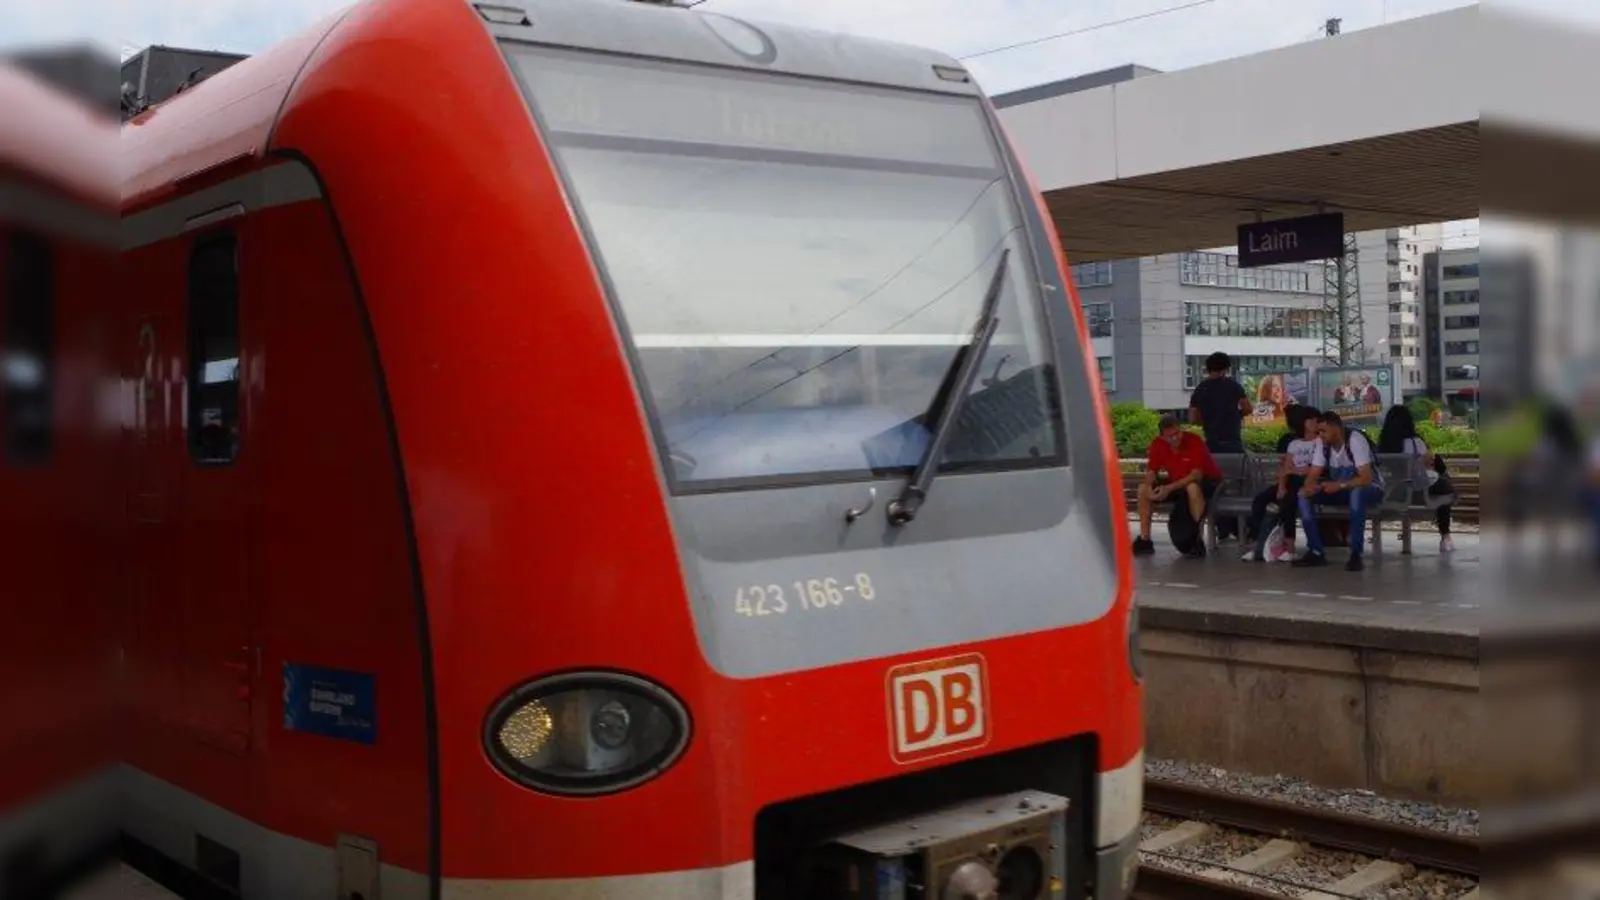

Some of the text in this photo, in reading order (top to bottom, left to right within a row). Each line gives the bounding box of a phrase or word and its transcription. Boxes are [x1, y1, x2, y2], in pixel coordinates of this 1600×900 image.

[1248, 228, 1299, 253] Laim
[734, 572, 876, 617] 423 166-8
[899, 670, 978, 746] DB
